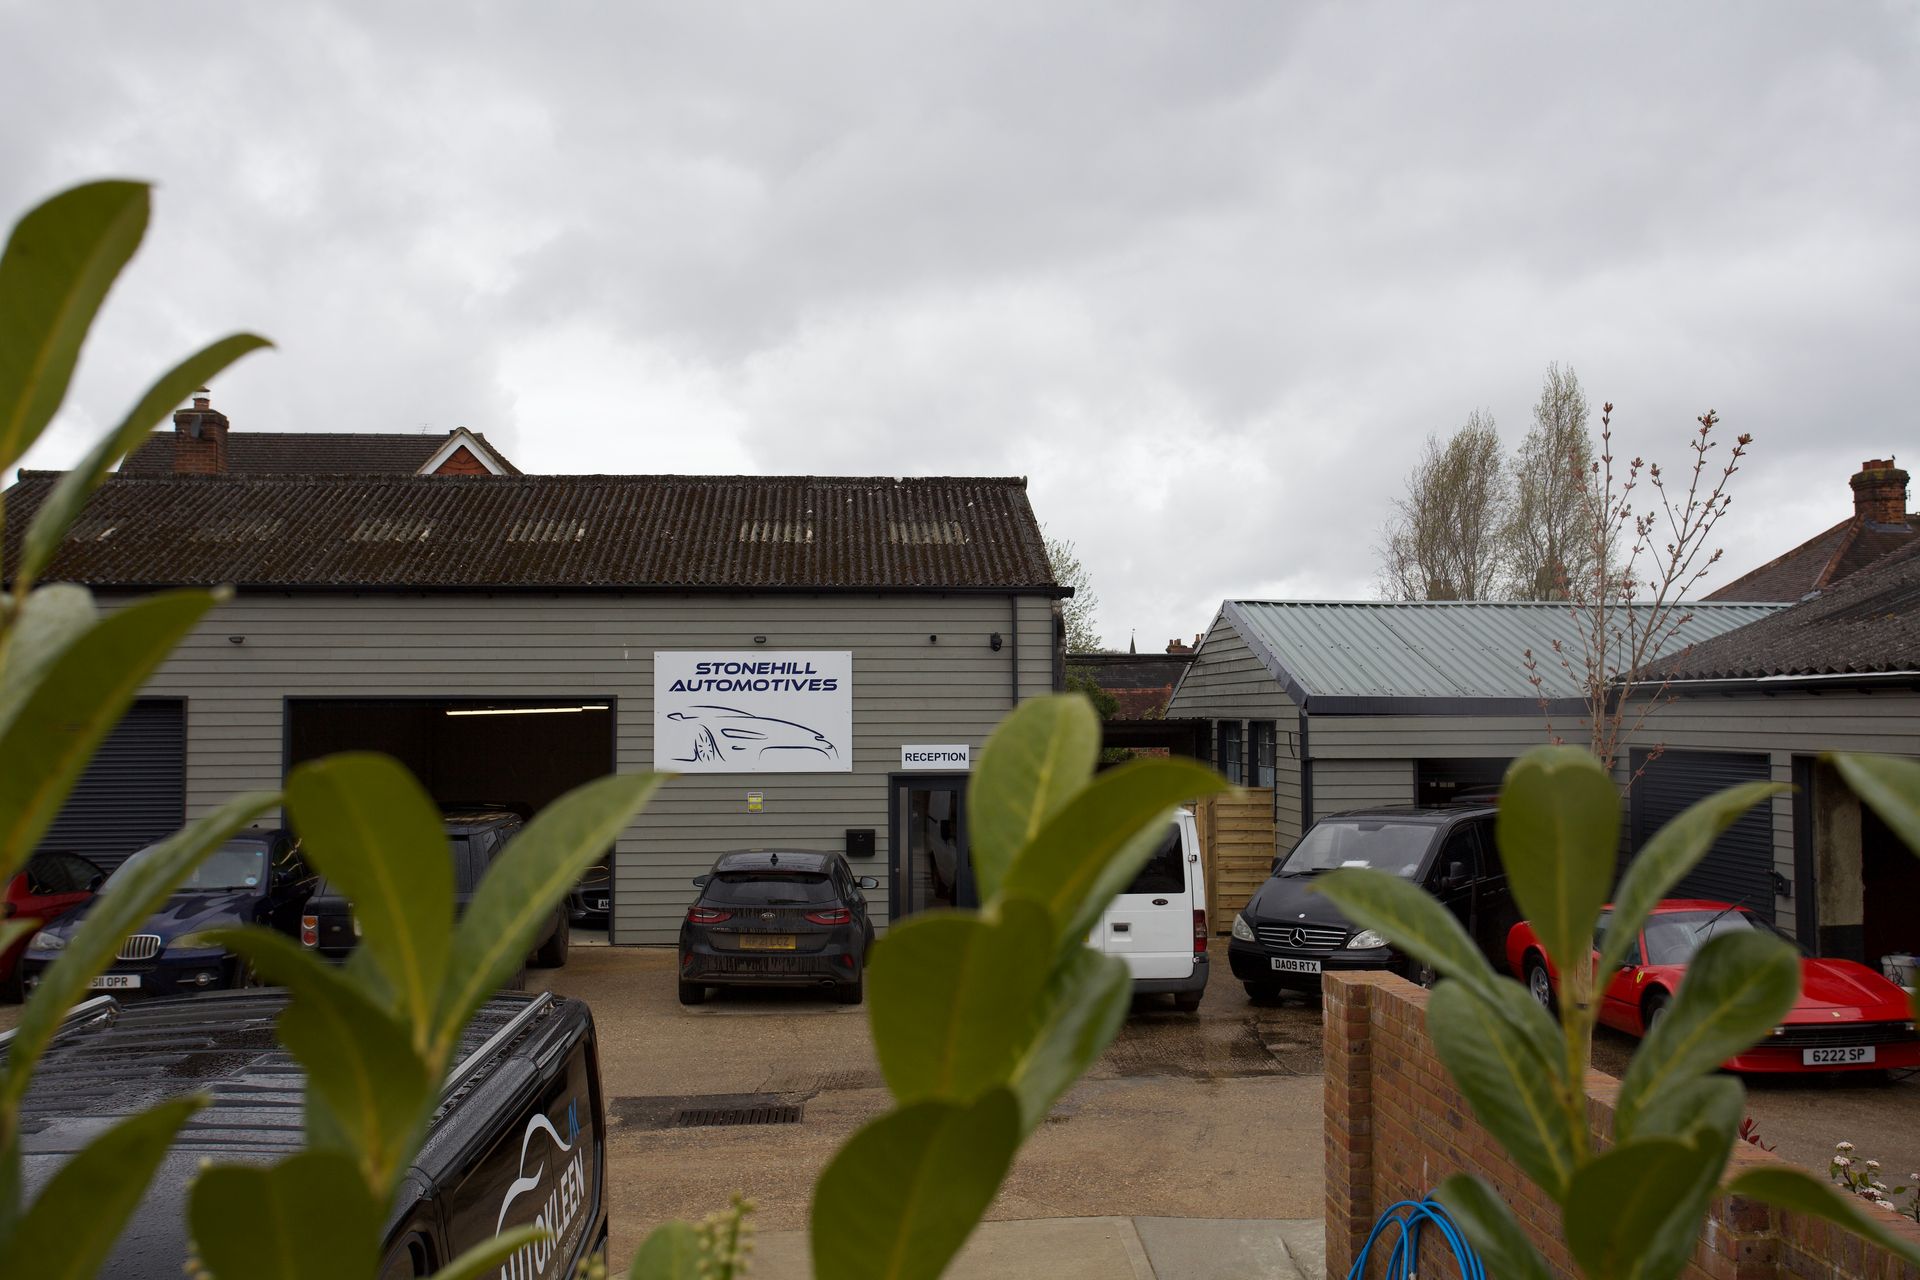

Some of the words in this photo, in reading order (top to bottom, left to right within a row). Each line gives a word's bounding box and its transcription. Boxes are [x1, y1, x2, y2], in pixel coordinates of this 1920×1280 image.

[695, 662, 818, 675] STONEHILL
[668, 678, 838, 692] AUTOMOTIVES
[904, 752, 966, 762] RECEPTION
[1275, 959, 1298, 970] DA09
[1299, 961, 1317, 972] RTX
[106, 976, 128, 987] OPR
[1812, 1049, 1846, 1062] 6222
[1848, 1048, 1865, 1061] SP
